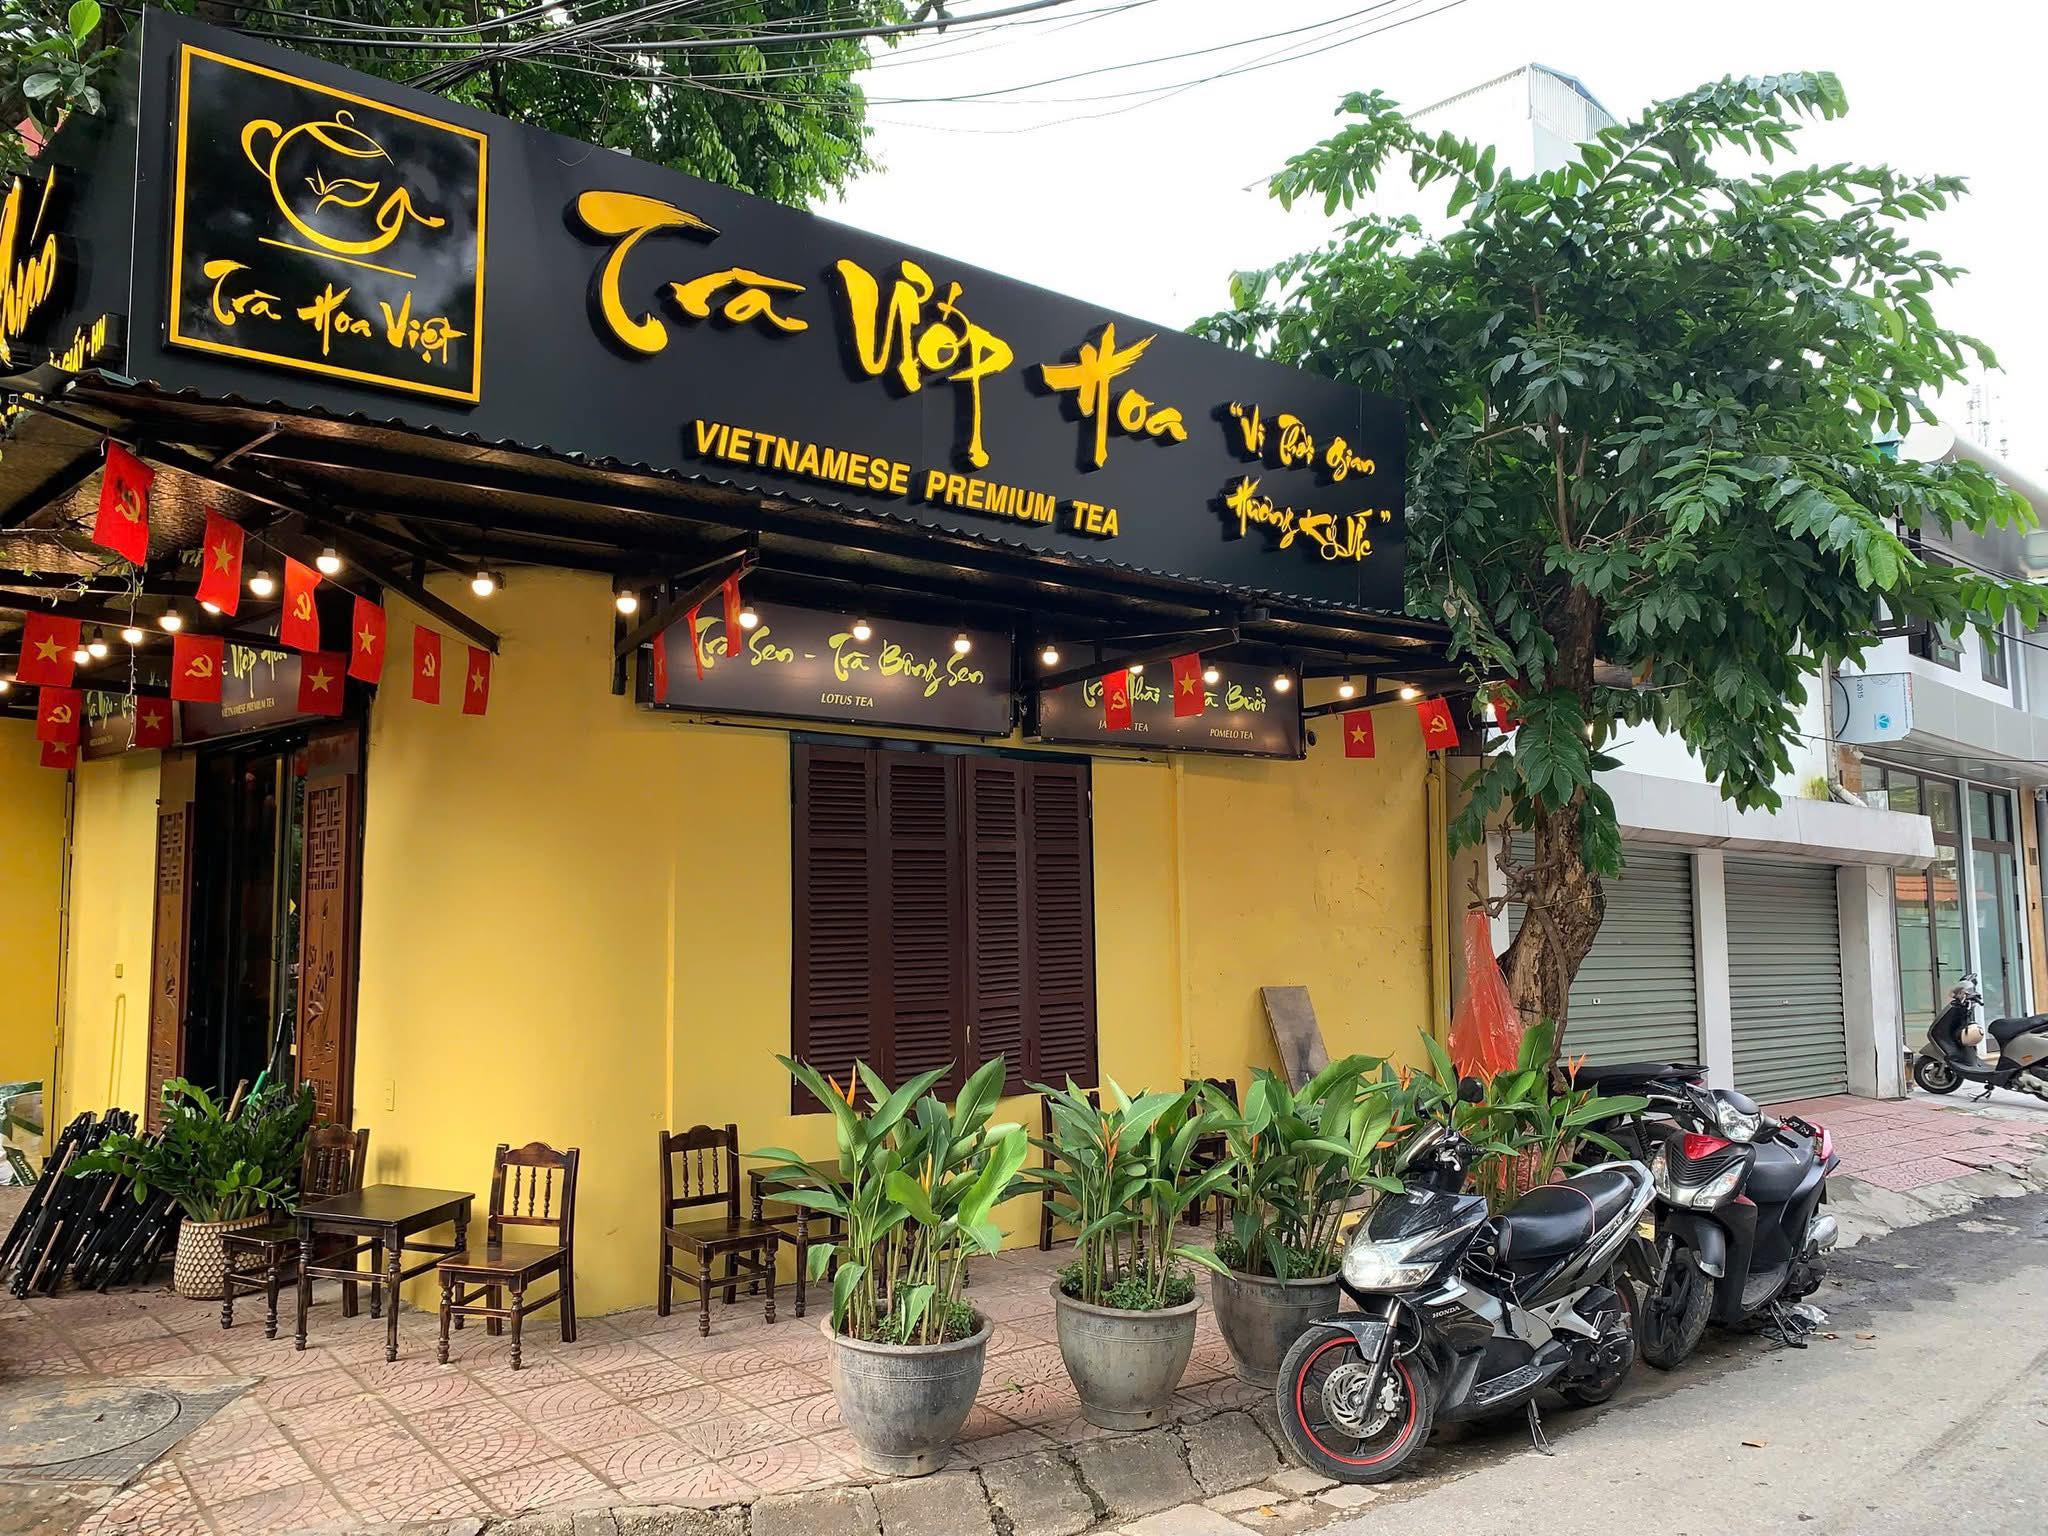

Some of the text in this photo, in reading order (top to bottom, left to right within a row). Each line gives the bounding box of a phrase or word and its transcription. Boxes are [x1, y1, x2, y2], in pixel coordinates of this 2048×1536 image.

[296, 282, 372, 357] Hoa
[1041, 322, 1188, 468] Hoa
[696, 420, 1119, 537] VIETNAMESE PREMIUM TEA
[749, 625, 795, 666] Sen
[946, 652, 984, 687] Sen
[821, 693, 874, 707] LOTUS TEA
[1134, 722, 1149, 732] TEA
[1210, 728, 1254, 741] POMELO TEA
[1432, 1305, 1461, 1319] HONDA
